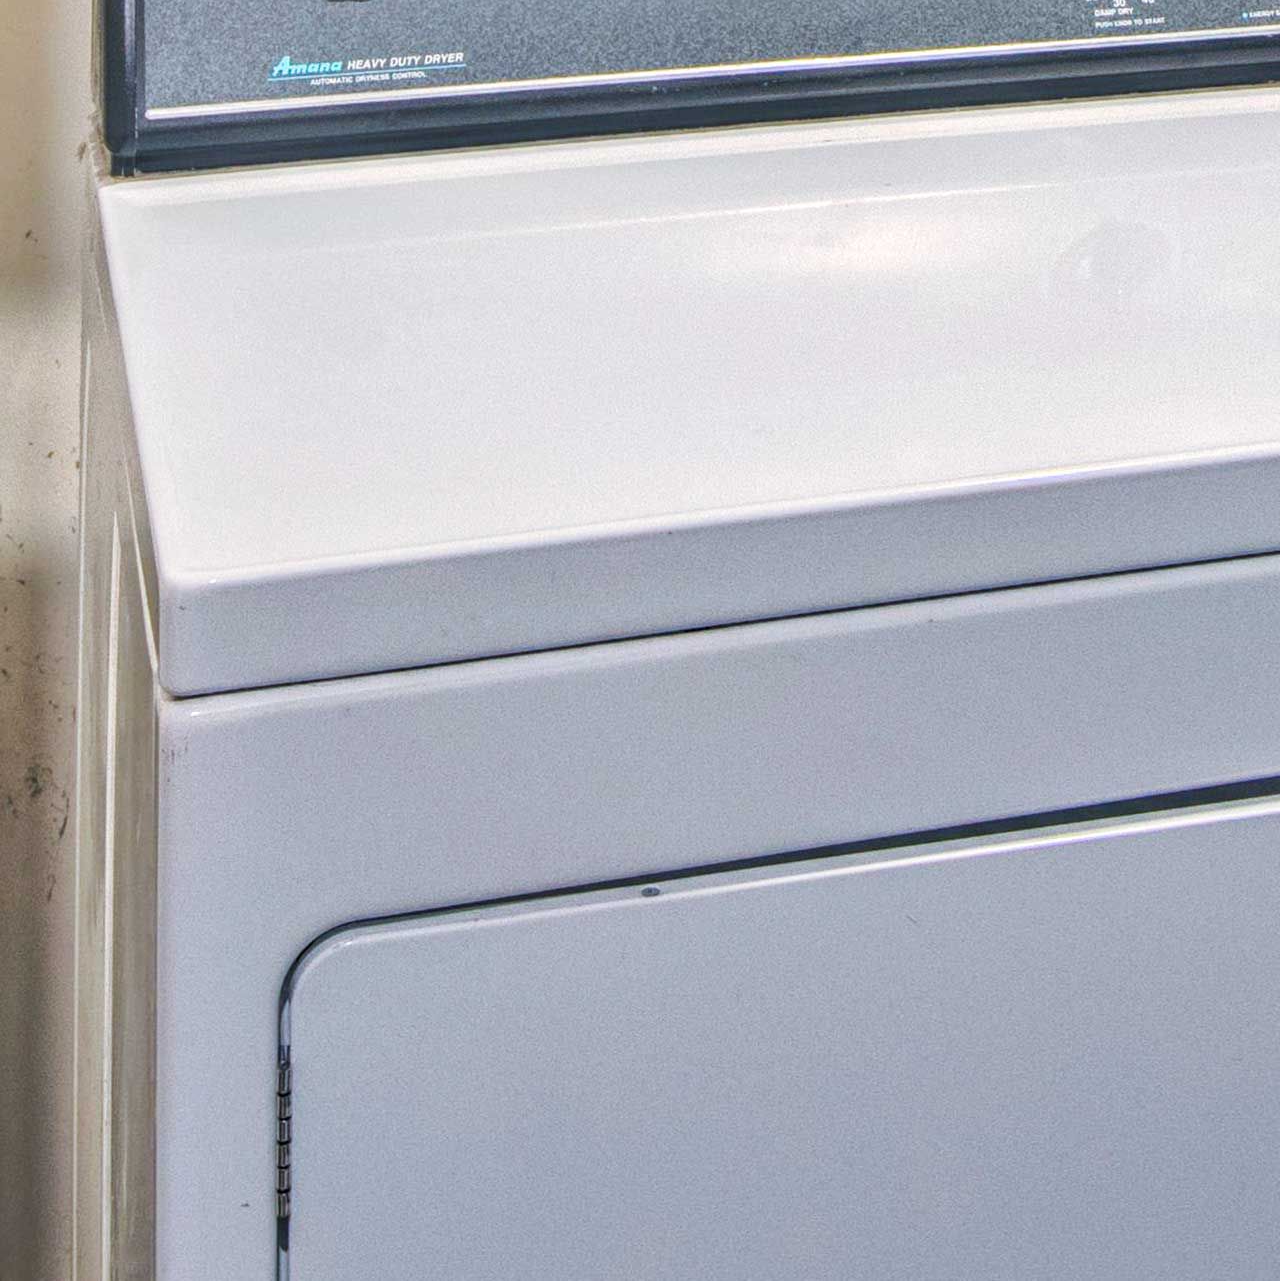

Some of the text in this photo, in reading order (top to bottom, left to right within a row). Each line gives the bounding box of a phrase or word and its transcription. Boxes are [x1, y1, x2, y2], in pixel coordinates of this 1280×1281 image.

[1117, 7, 1134, 16] DRY
[272, 52, 465, 77] Amana HEAVY DUTY DRYER
[310, 76, 354, 86] AUTOMATIC
[391, 71, 428, 80] CONTROL
